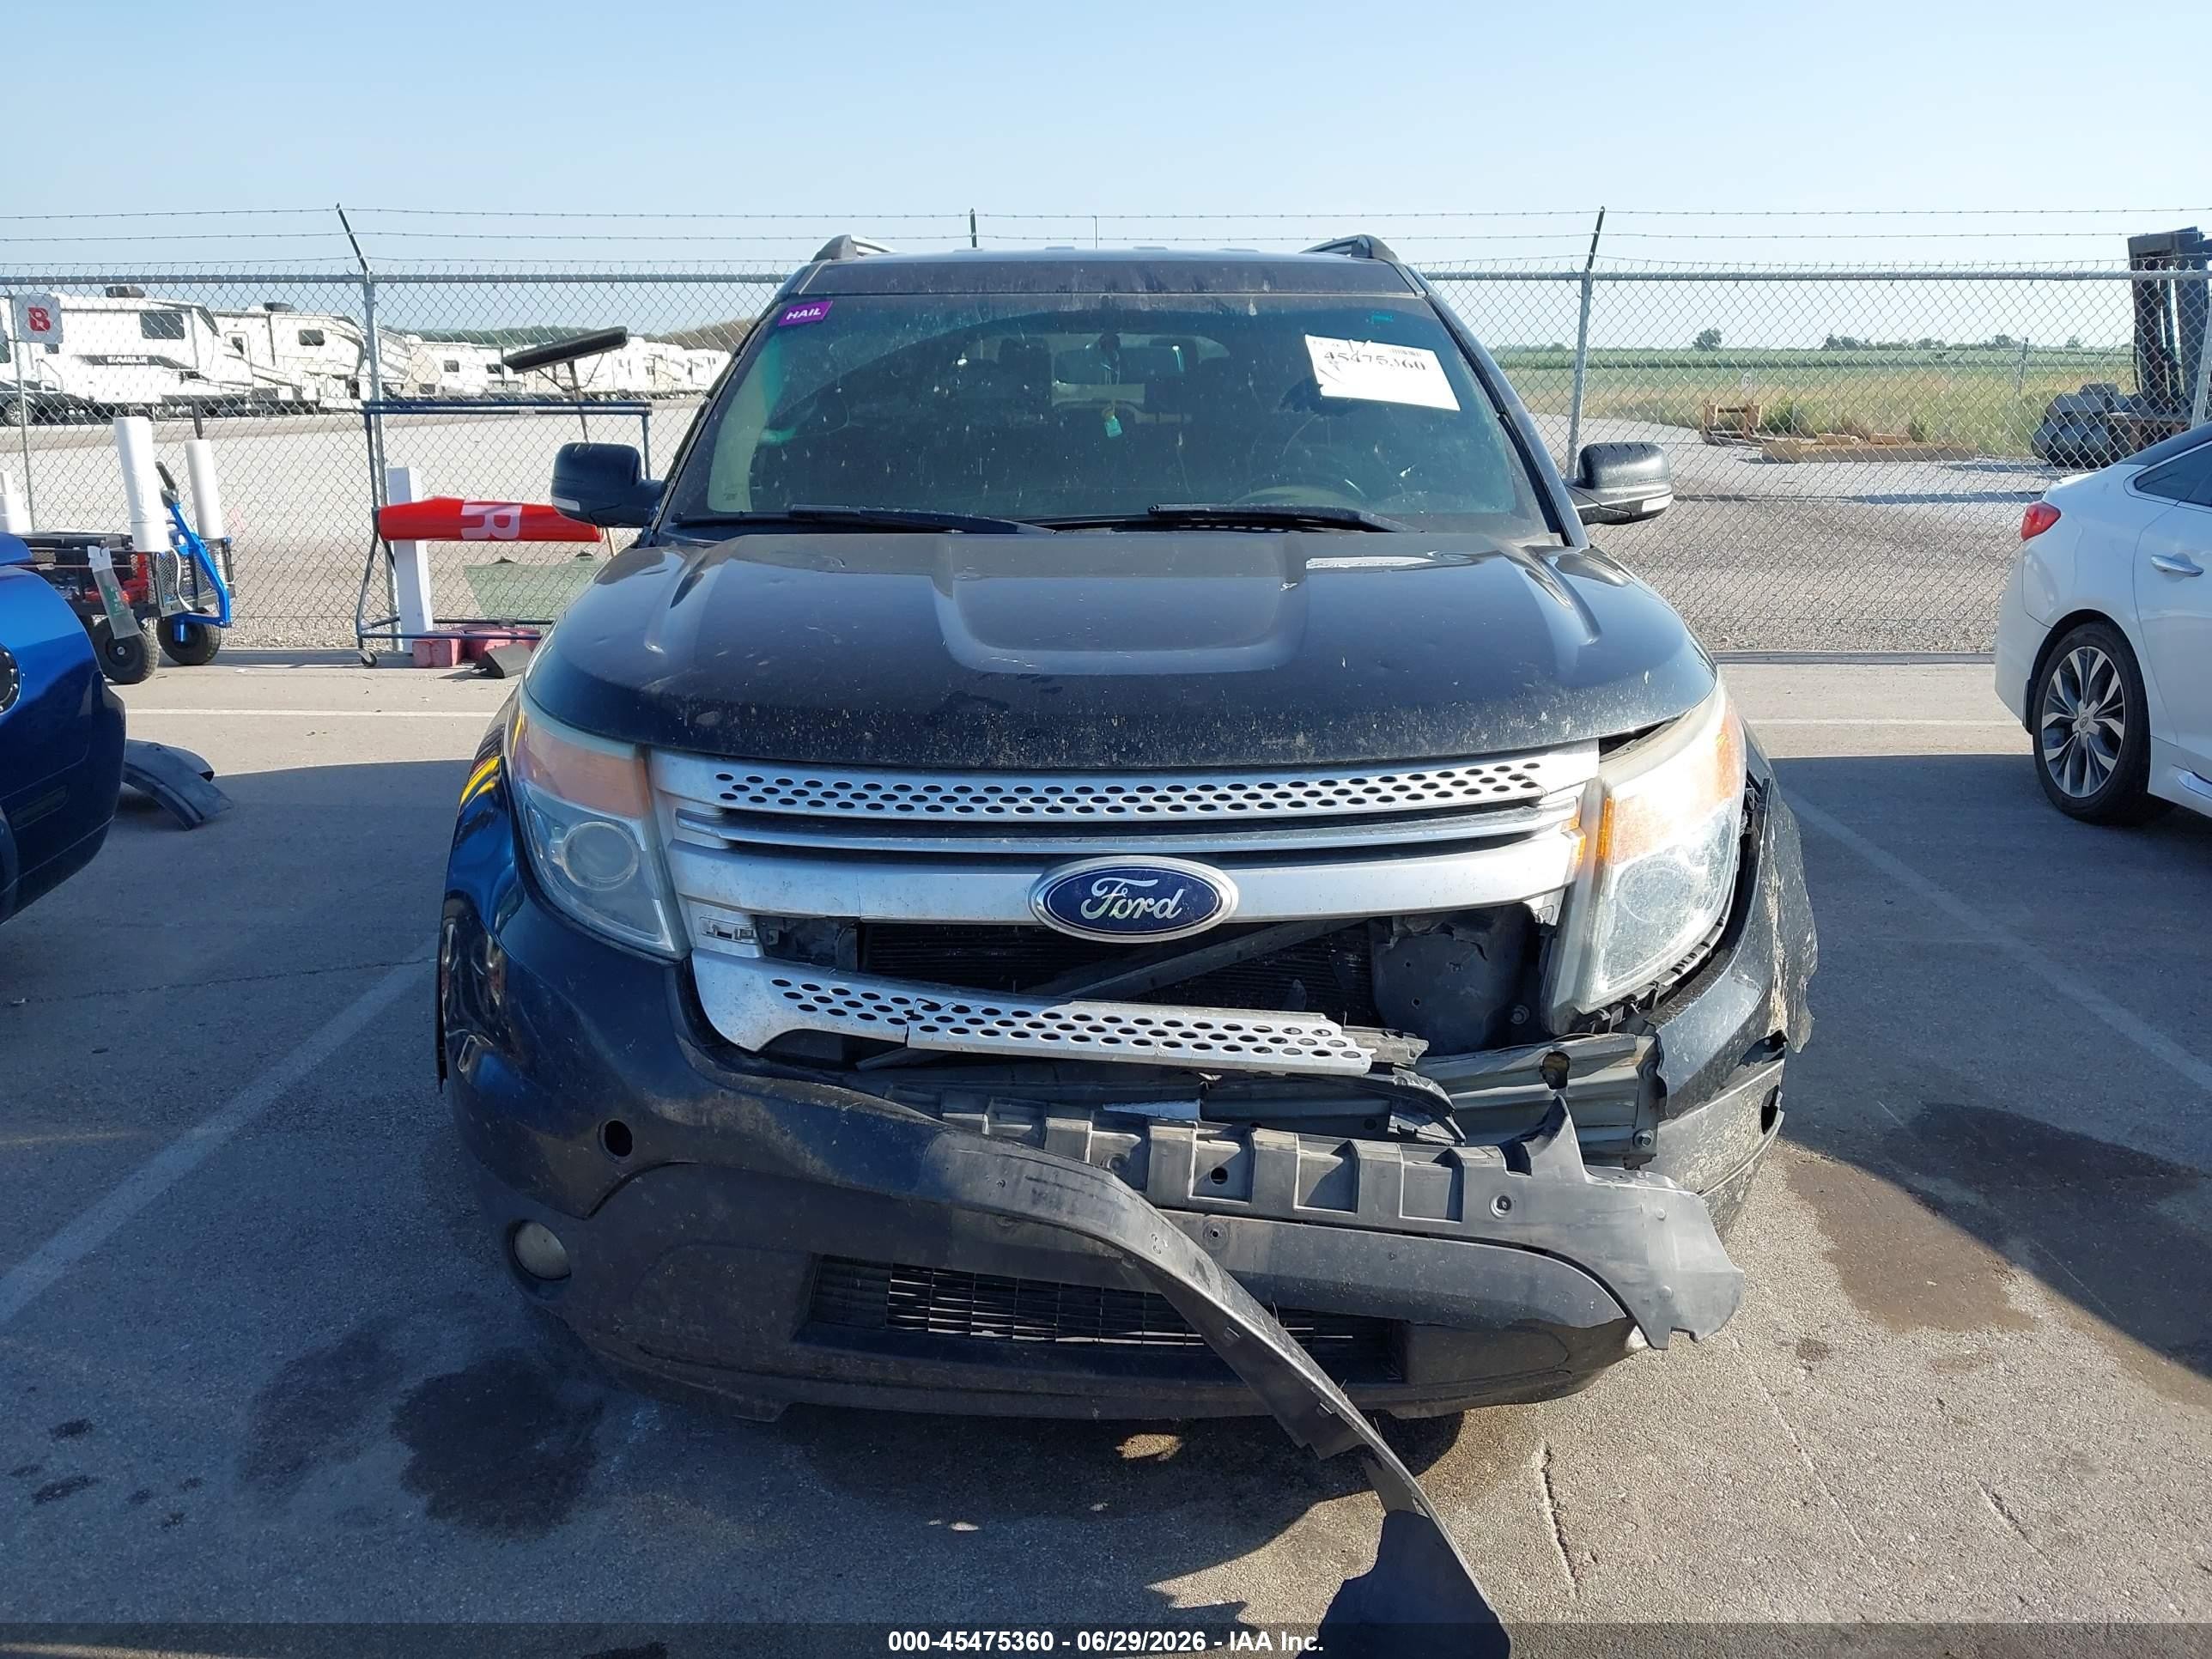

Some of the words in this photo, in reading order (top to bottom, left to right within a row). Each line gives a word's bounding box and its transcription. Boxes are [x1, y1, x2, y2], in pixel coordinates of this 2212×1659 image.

[27, 307, 52, 331] B
[786, 307, 822, 320] HAIL
[460, 504, 522, 540] R
[1080, 877, 1187, 920] Ford
